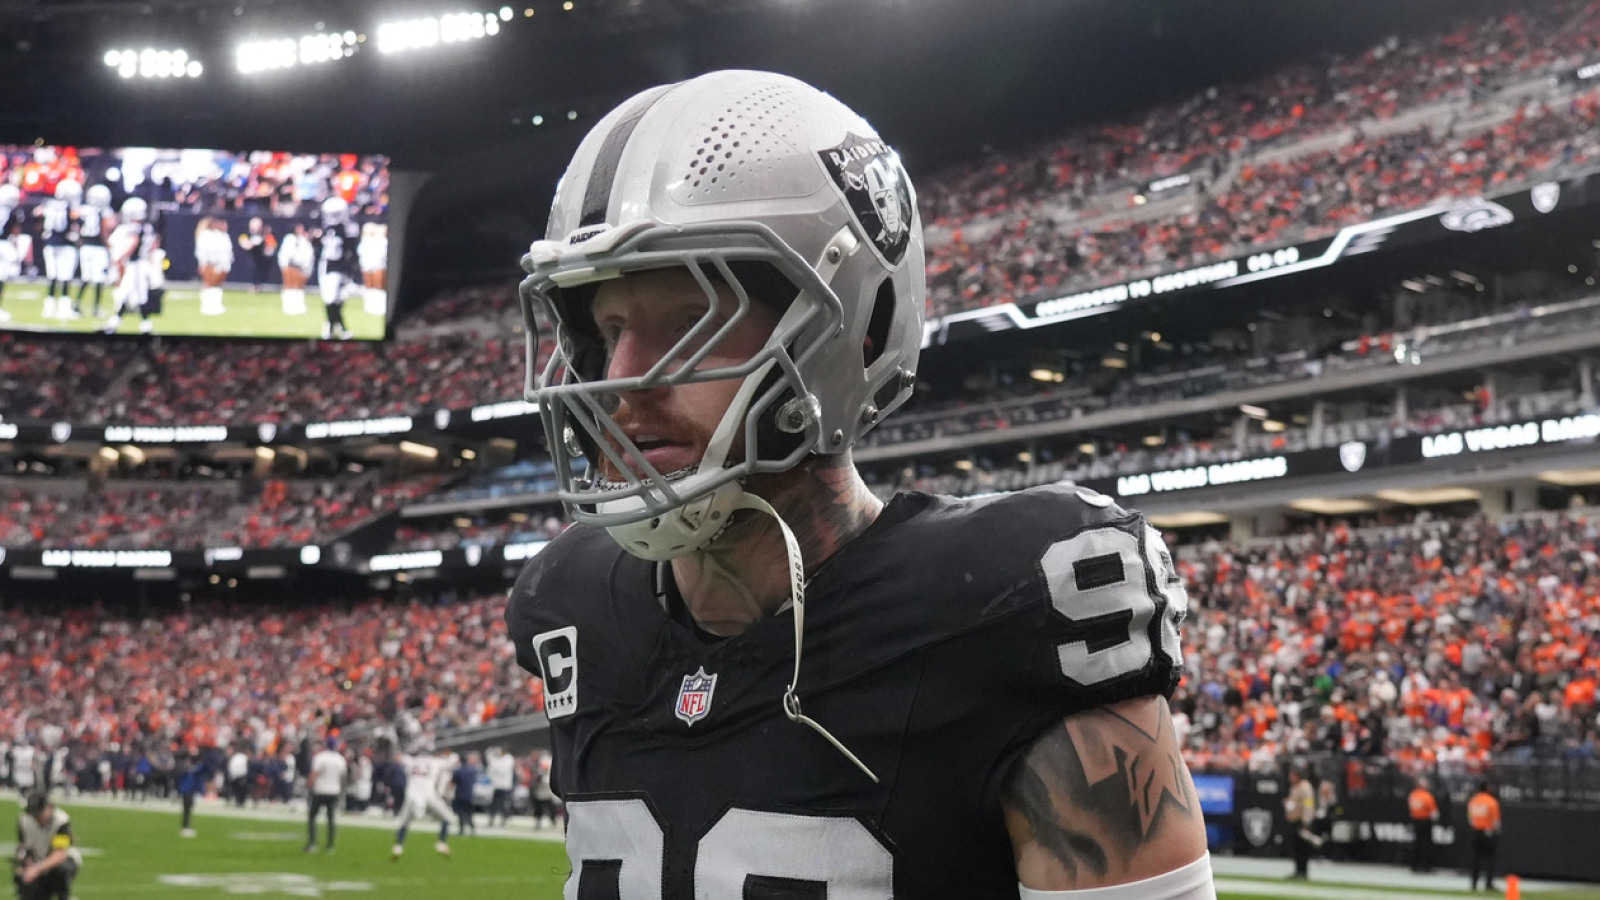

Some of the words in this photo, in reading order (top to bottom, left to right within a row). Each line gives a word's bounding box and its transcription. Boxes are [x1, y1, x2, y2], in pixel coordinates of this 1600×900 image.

[1421, 432, 1463, 457] LAS
[1464, 422, 1539, 451] VEGAS
[1541, 414, 1600, 442] RAID
[1117, 474, 1150, 496] LAS
[1151, 466, 1208, 491] VEGAS
[539, 635, 573, 695] C
[680, 693, 704, 715] NFL
